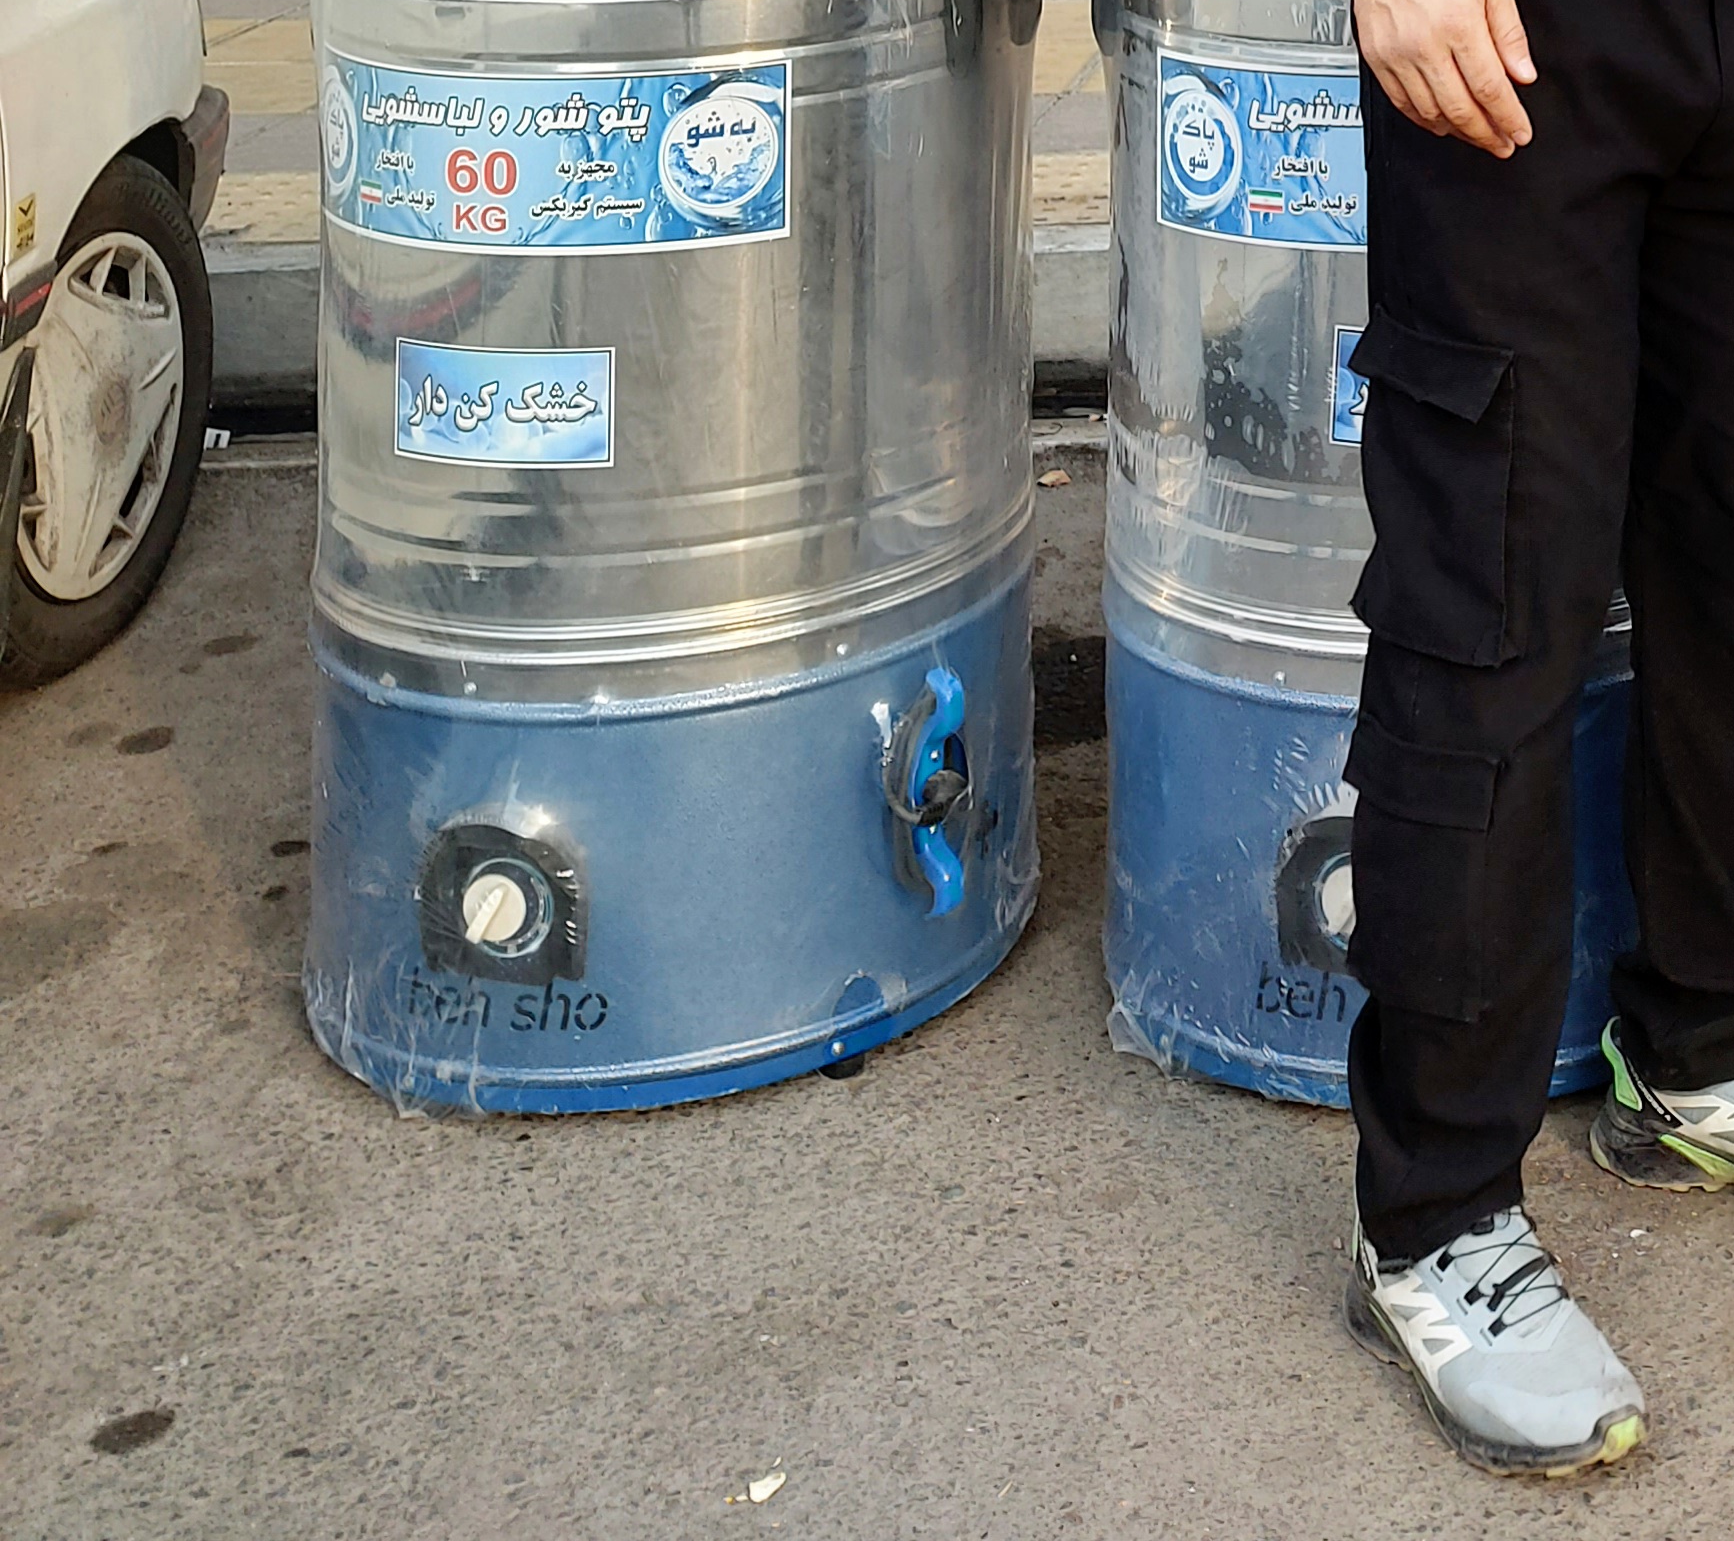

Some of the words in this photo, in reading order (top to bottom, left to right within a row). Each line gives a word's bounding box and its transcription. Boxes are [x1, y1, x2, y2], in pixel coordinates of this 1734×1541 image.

[489, 108, 511, 137] و
[516, 92, 588, 137] شور
[596, 96, 652, 144] پتو
[445, 147, 519, 196] 60
[452, 203, 509, 234] KG
[407, 375, 449, 427] دار
[453, 379, 499, 432] کن
[504, 379, 599, 425] خشک
[509, 980, 609, 1032] sho
[1256, 960, 1347, 1023] beh
